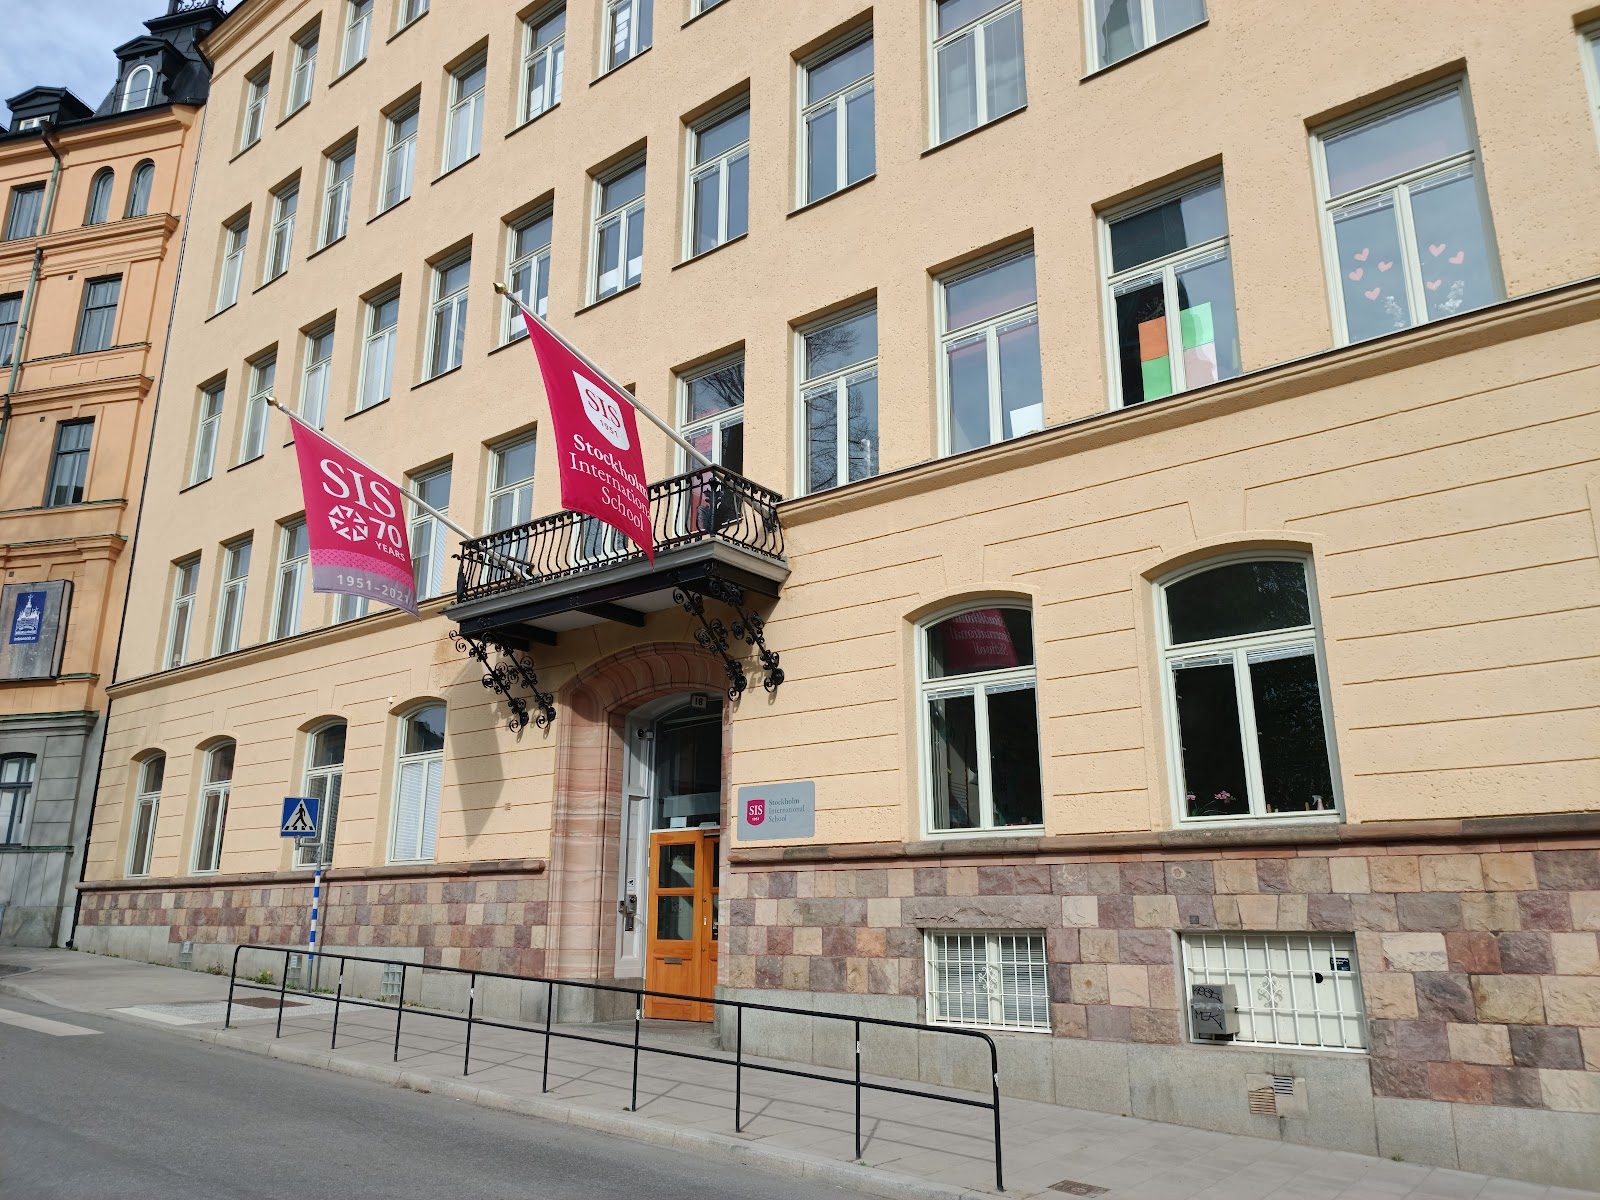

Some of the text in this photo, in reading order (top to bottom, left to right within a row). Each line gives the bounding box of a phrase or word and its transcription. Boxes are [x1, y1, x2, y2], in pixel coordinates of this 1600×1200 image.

[586, 389, 620, 427] SIS
[600, 420, 618, 437] 1951
[573, 434, 649, 500] Stockholm
[320, 458, 396, 519] SIS
[569, 452, 651, 521] Internation
[601, 486, 643, 531] School
[369, 516, 402, 548] 70
[375, 541, 405, 561] YEARS
[337, 574, 410, 603] 1951-2021
[748, 804, 763, 816] SIS
[769, 798, 800, 806] Stockholm
[769, 805, 805, 814] International
[769, 815, 787, 823] School
